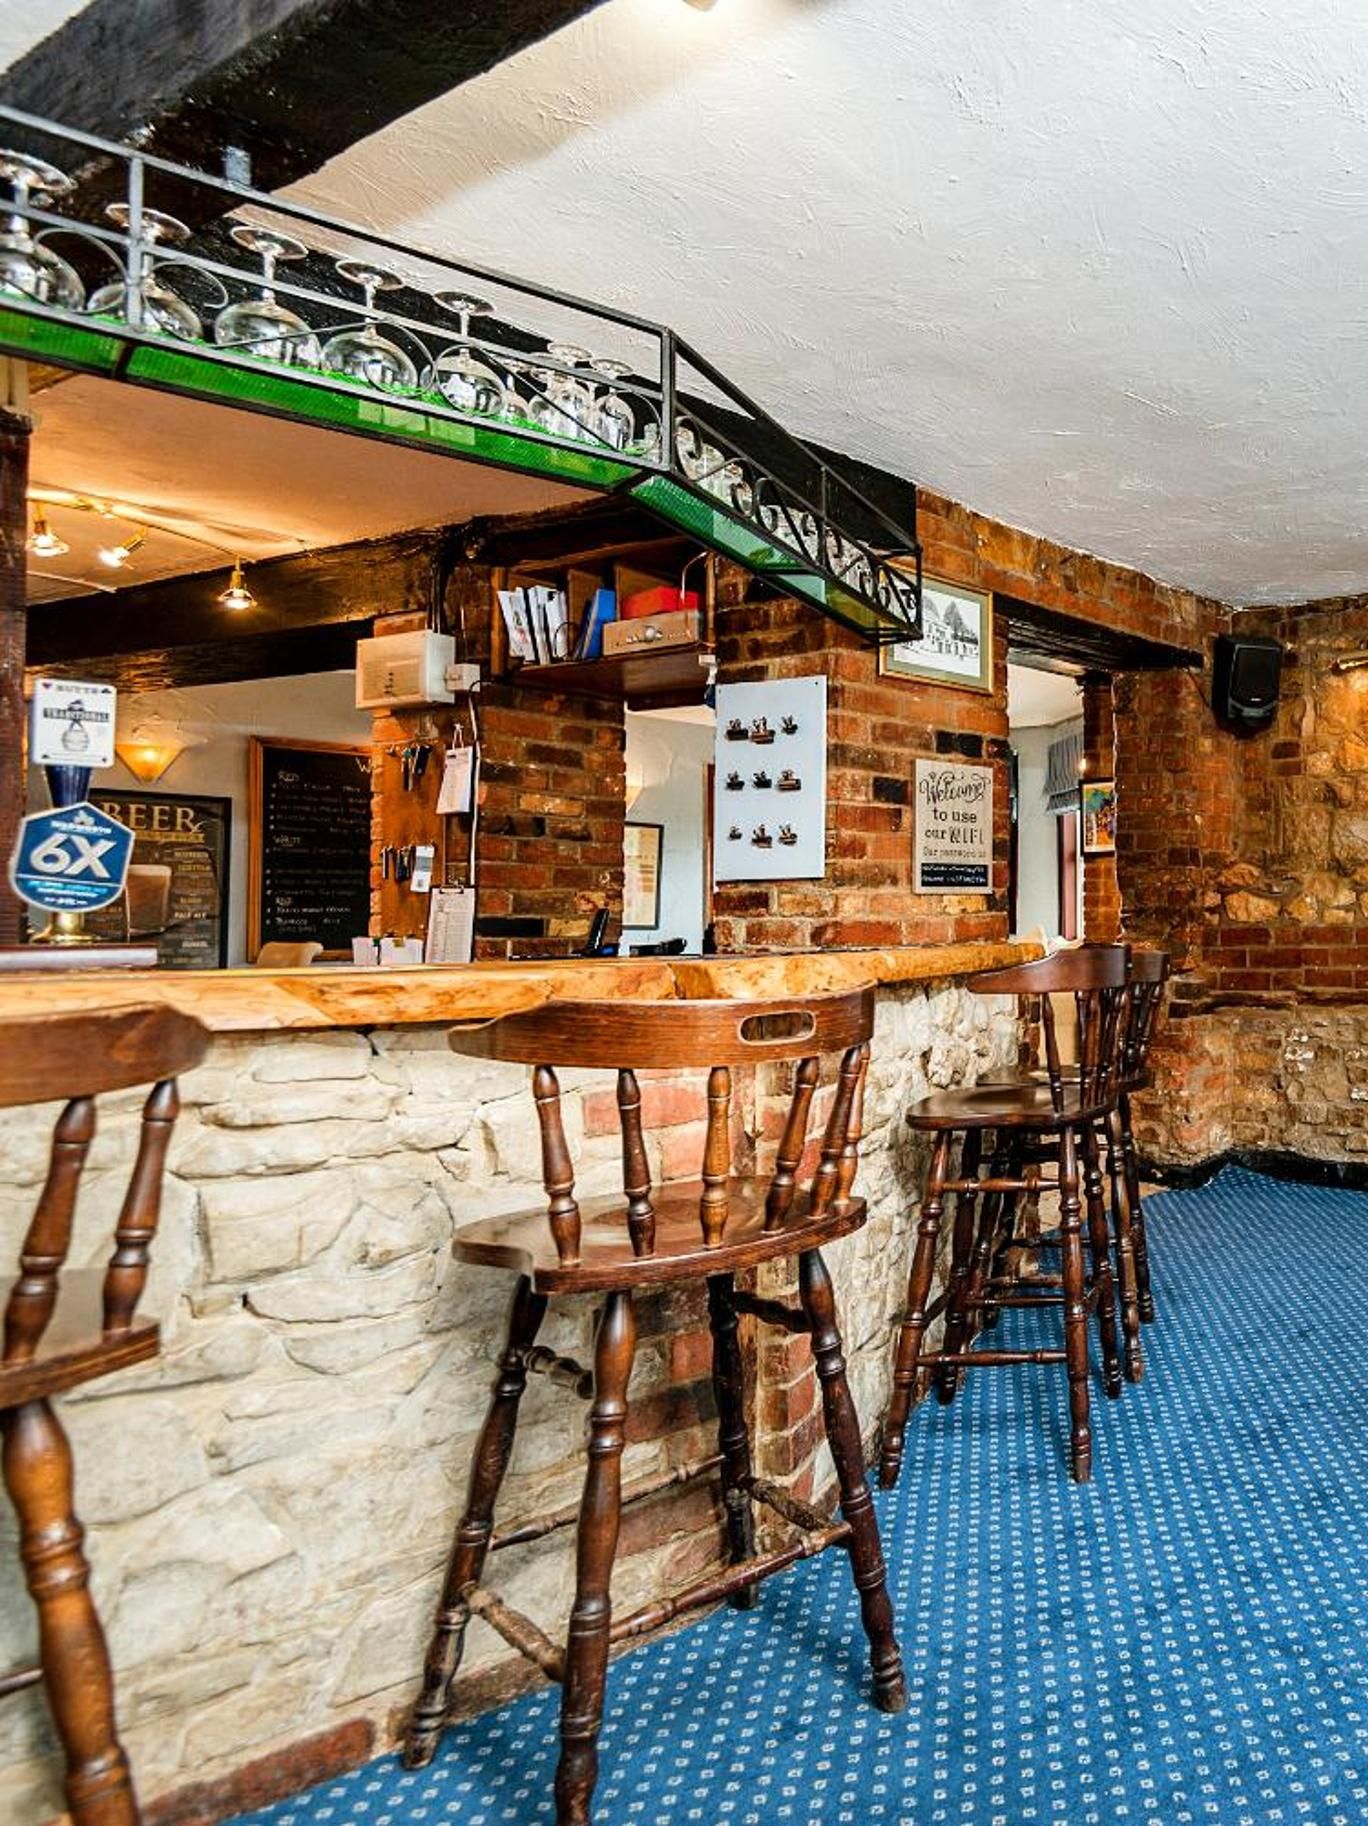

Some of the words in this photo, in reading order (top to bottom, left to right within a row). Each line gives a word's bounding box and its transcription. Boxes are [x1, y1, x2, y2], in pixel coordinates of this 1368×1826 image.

[919, 771, 991, 805] Welcome
[100, 802, 206, 833] BEER
[932, 807, 948, 822] to
[952, 810, 977, 823] use
[924, 828, 947, 840] our
[949, 826, 984, 844] WIFI
[29, 832, 117, 878] 6X
